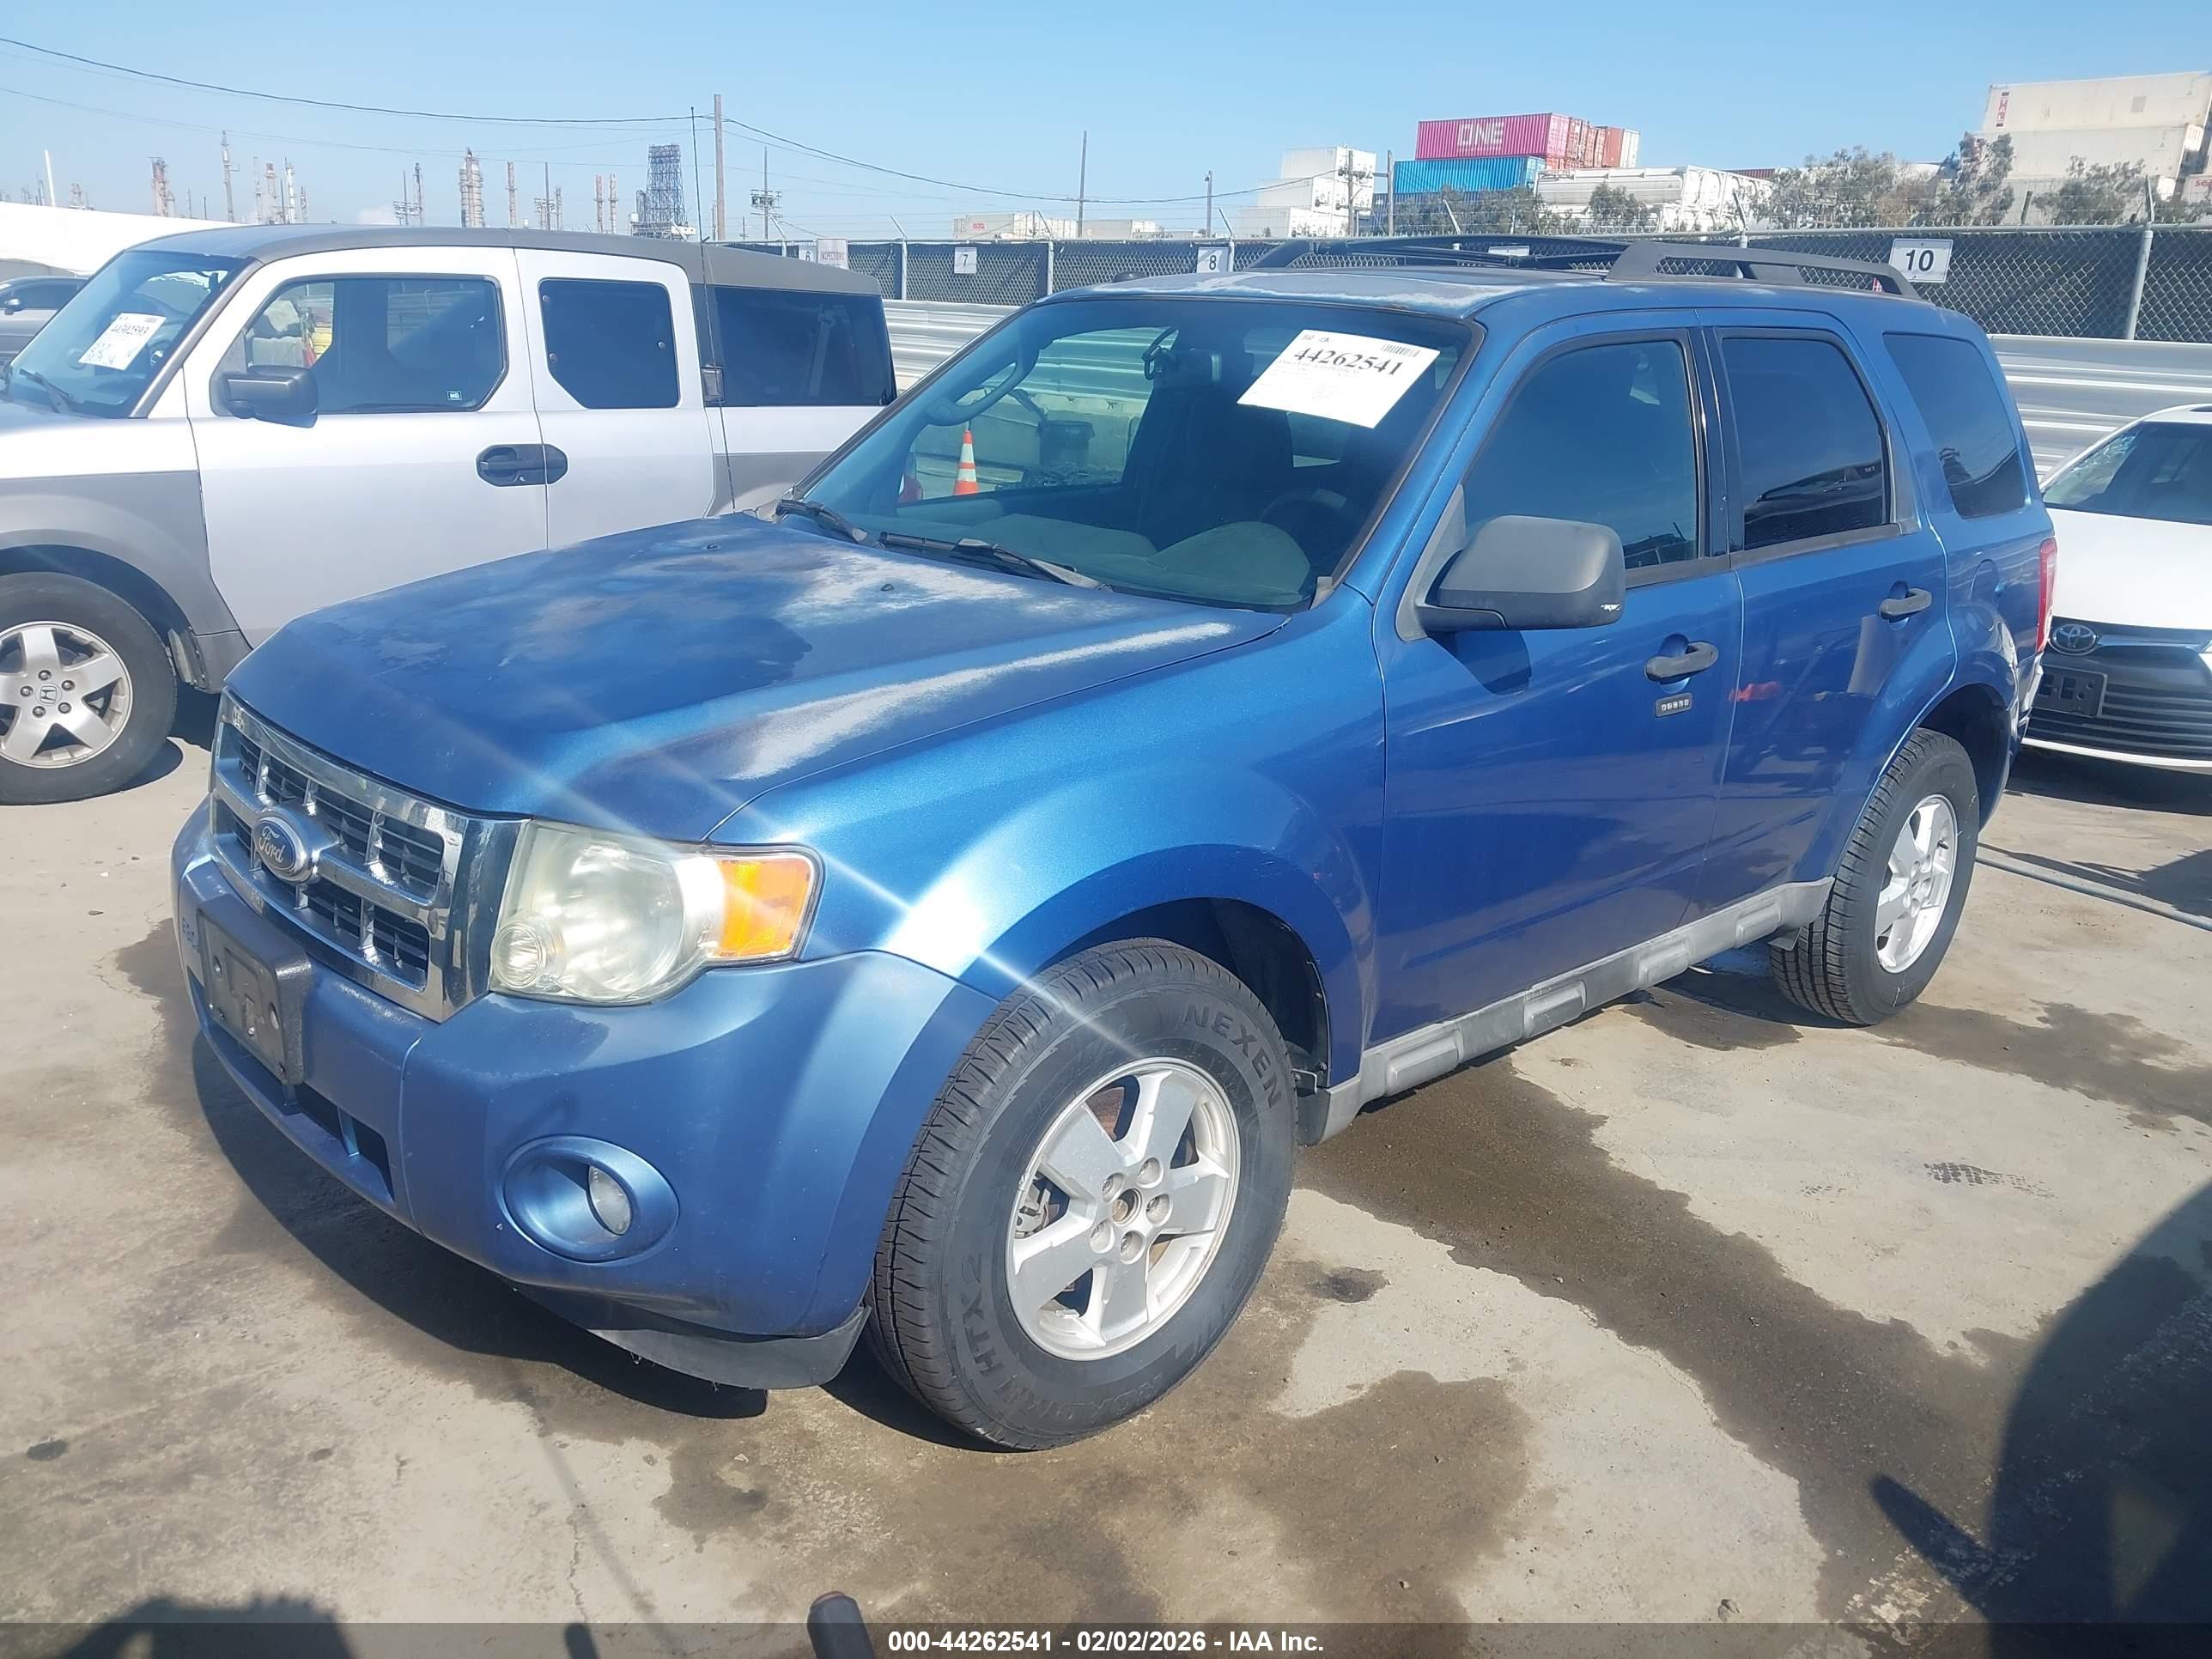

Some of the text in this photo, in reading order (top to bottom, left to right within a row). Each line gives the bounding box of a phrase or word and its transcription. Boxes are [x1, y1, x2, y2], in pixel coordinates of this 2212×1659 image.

[1456, 122, 1504, 146] ONE
[962, 253, 969, 267] 7
[1208, 254, 1217, 271] 8
[1905, 249, 1935, 272] 10
[1293, 347, 1404, 375] 44262541
[258, 825, 286, 863] Ford
[1182, 1003, 1282, 1109] NEXEN
[960, 1253, 1004, 1377] HTX2
